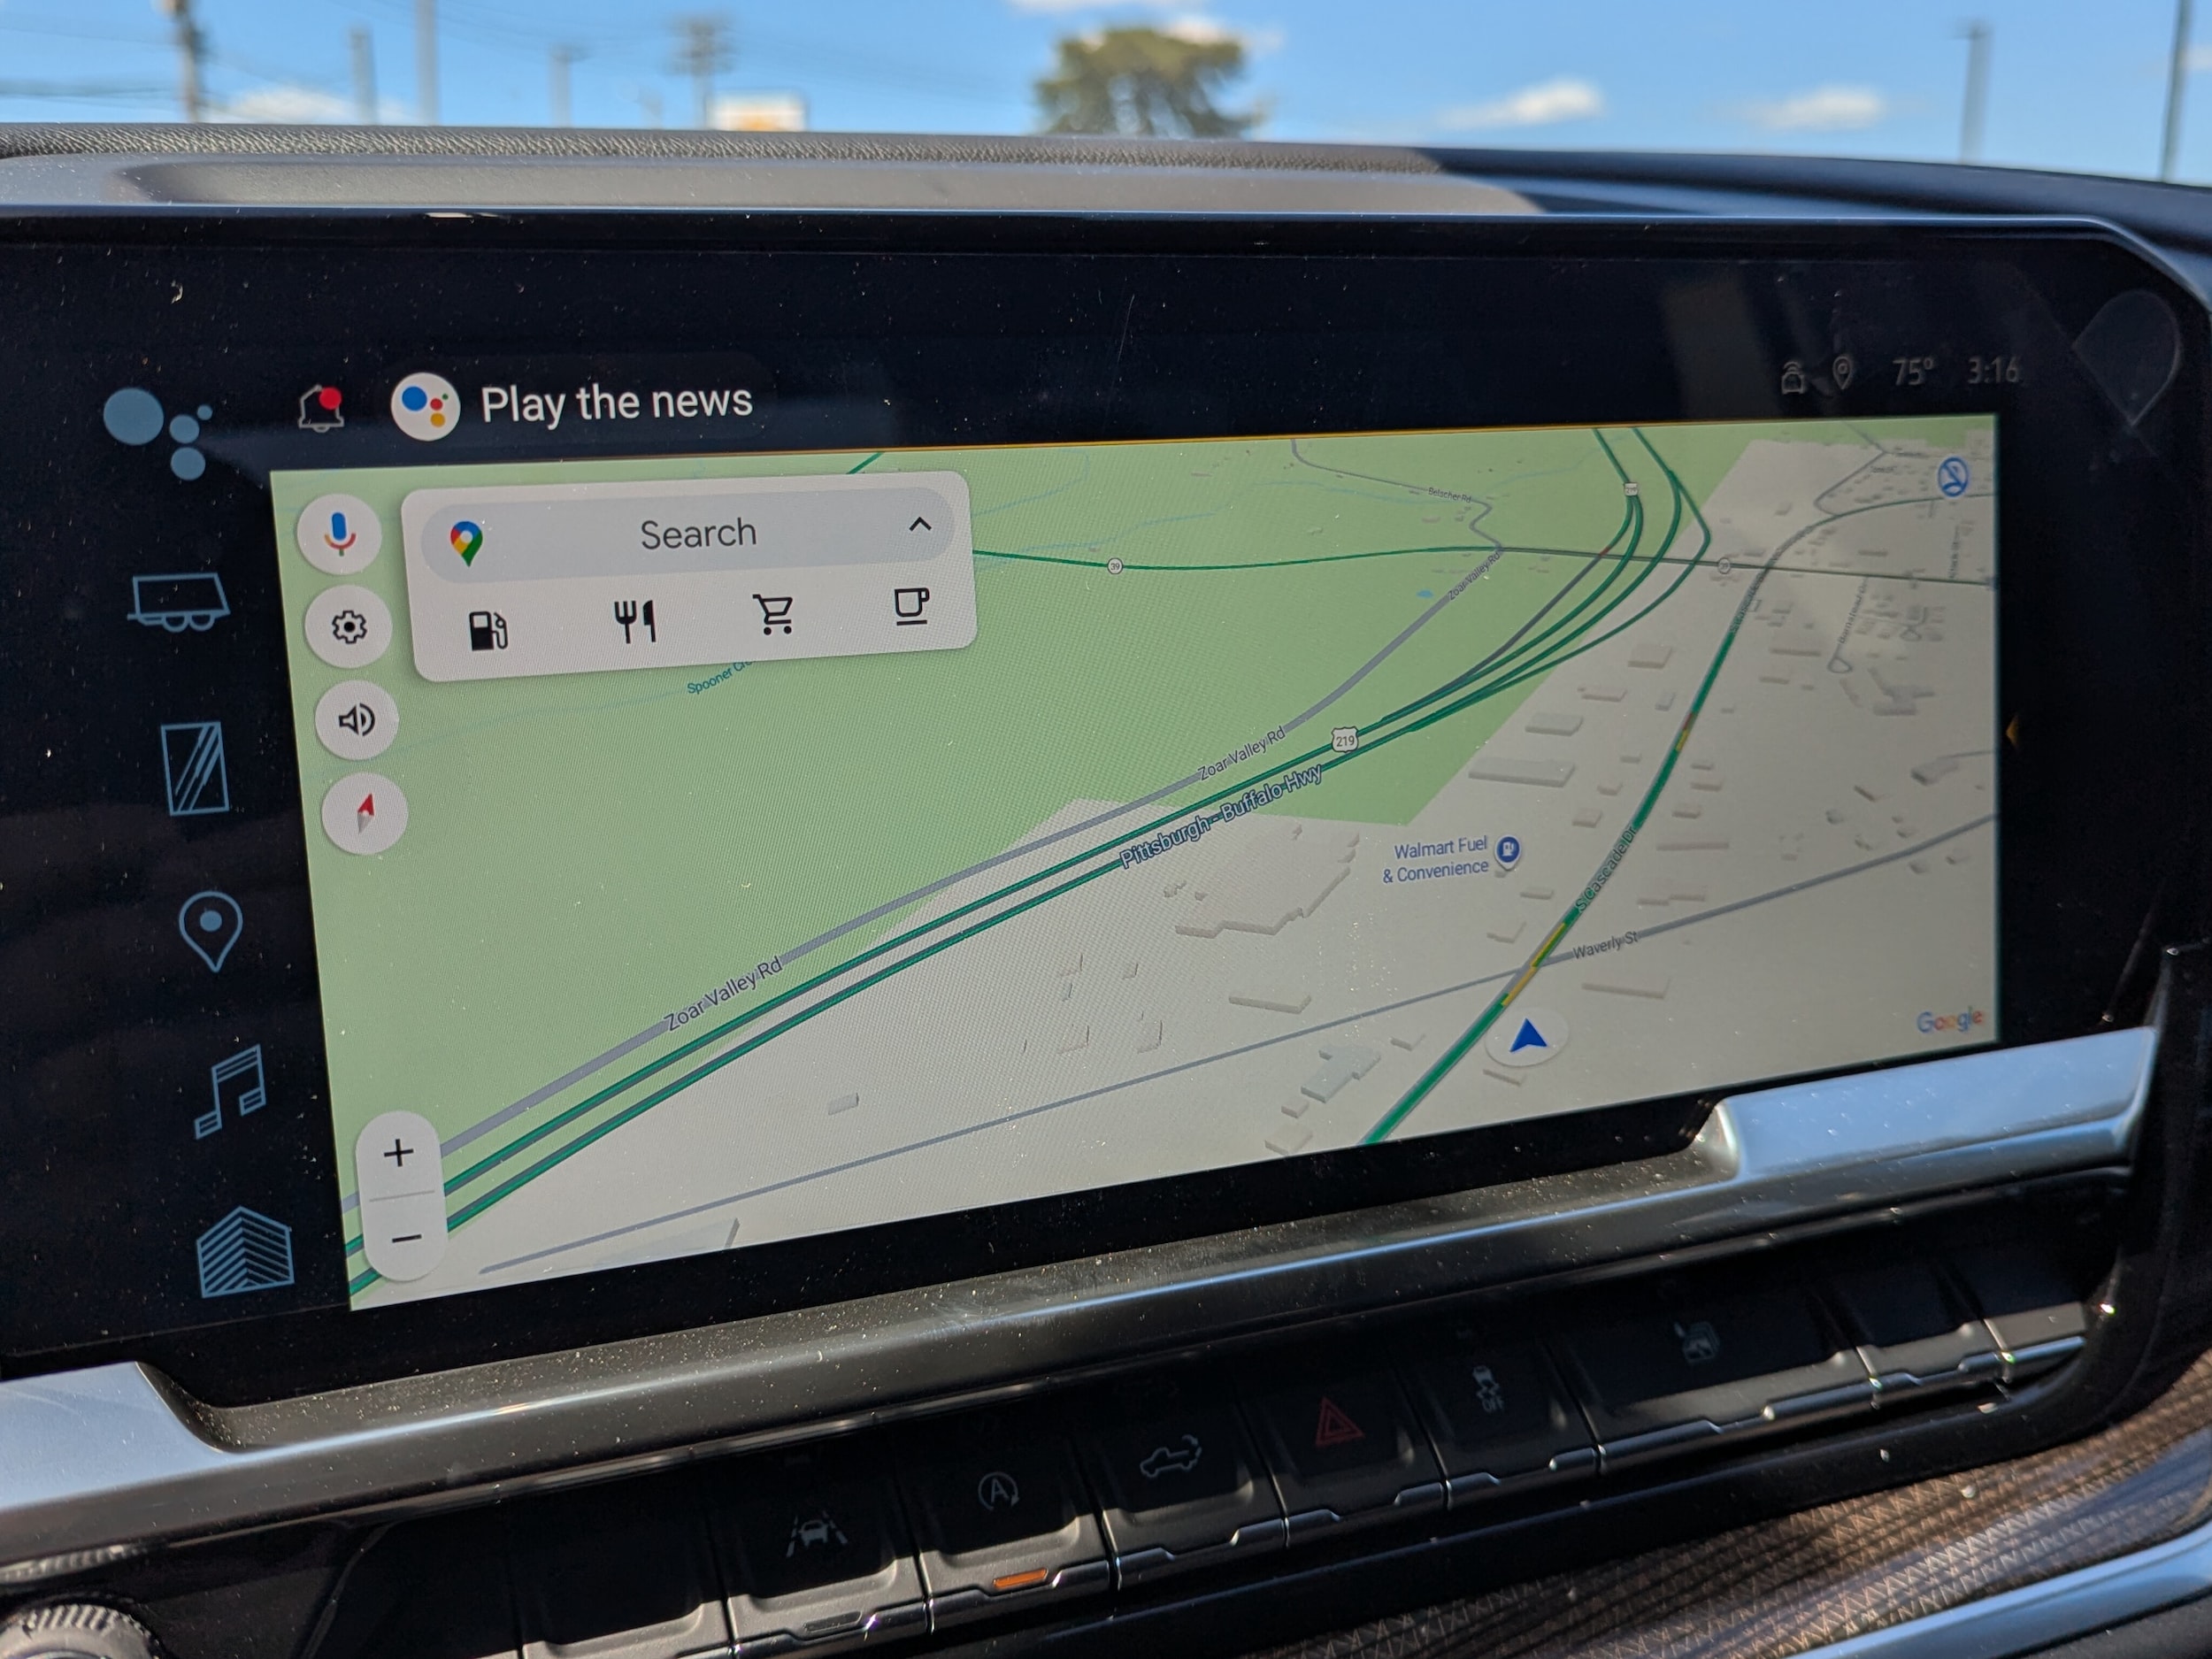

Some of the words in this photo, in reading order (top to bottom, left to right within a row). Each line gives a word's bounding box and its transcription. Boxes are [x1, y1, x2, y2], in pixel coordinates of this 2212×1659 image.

[1967, 357, 2021, 384] 3:16
[481, 384, 566, 431] Play
[576, 383, 641, 420] the
[652, 389, 753, 419] news
[1461, 494, 1472, 503] Rd
[641, 517, 757, 549] Search
[1448, 580, 1466, 601] Zoar
[1464, 562, 1489, 584] Valley
[1487, 551, 1501, 565] Rd
[687, 668, 733, 695] Spooner
[1197, 759, 1229, 781] Zoar
[1227, 740, 1267, 765] Valley
[1267, 726, 1286, 746] Rd
[1336, 735, 1355, 748] 219
[1119, 815, 1211, 870] Pittsburgh
[1219, 783, 1284, 822] Buffalo
[1283, 764, 1323, 794] Hwy
[1394, 841, 1454, 859] Walmart
[1458, 835, 1487, 852] Fuel
[1383, 869, 1393, 884] &
[1397, 861, 1489, 882] Convenience
[1575, 897, 1587, 912] S
[1584, 843, 1627, 901] Cascade
[1622, 826, 1637, 844] Dr
[1572, 935, 1623, 959] Waverly
[1624, 930, 1639, 945] St
[664, 1002, 705, 1032] Zoar
[704, 973, 757, 1007] Valley
[757, 956, 783, 979] Rd
[1916, 1005, 1985, 1033] Google
